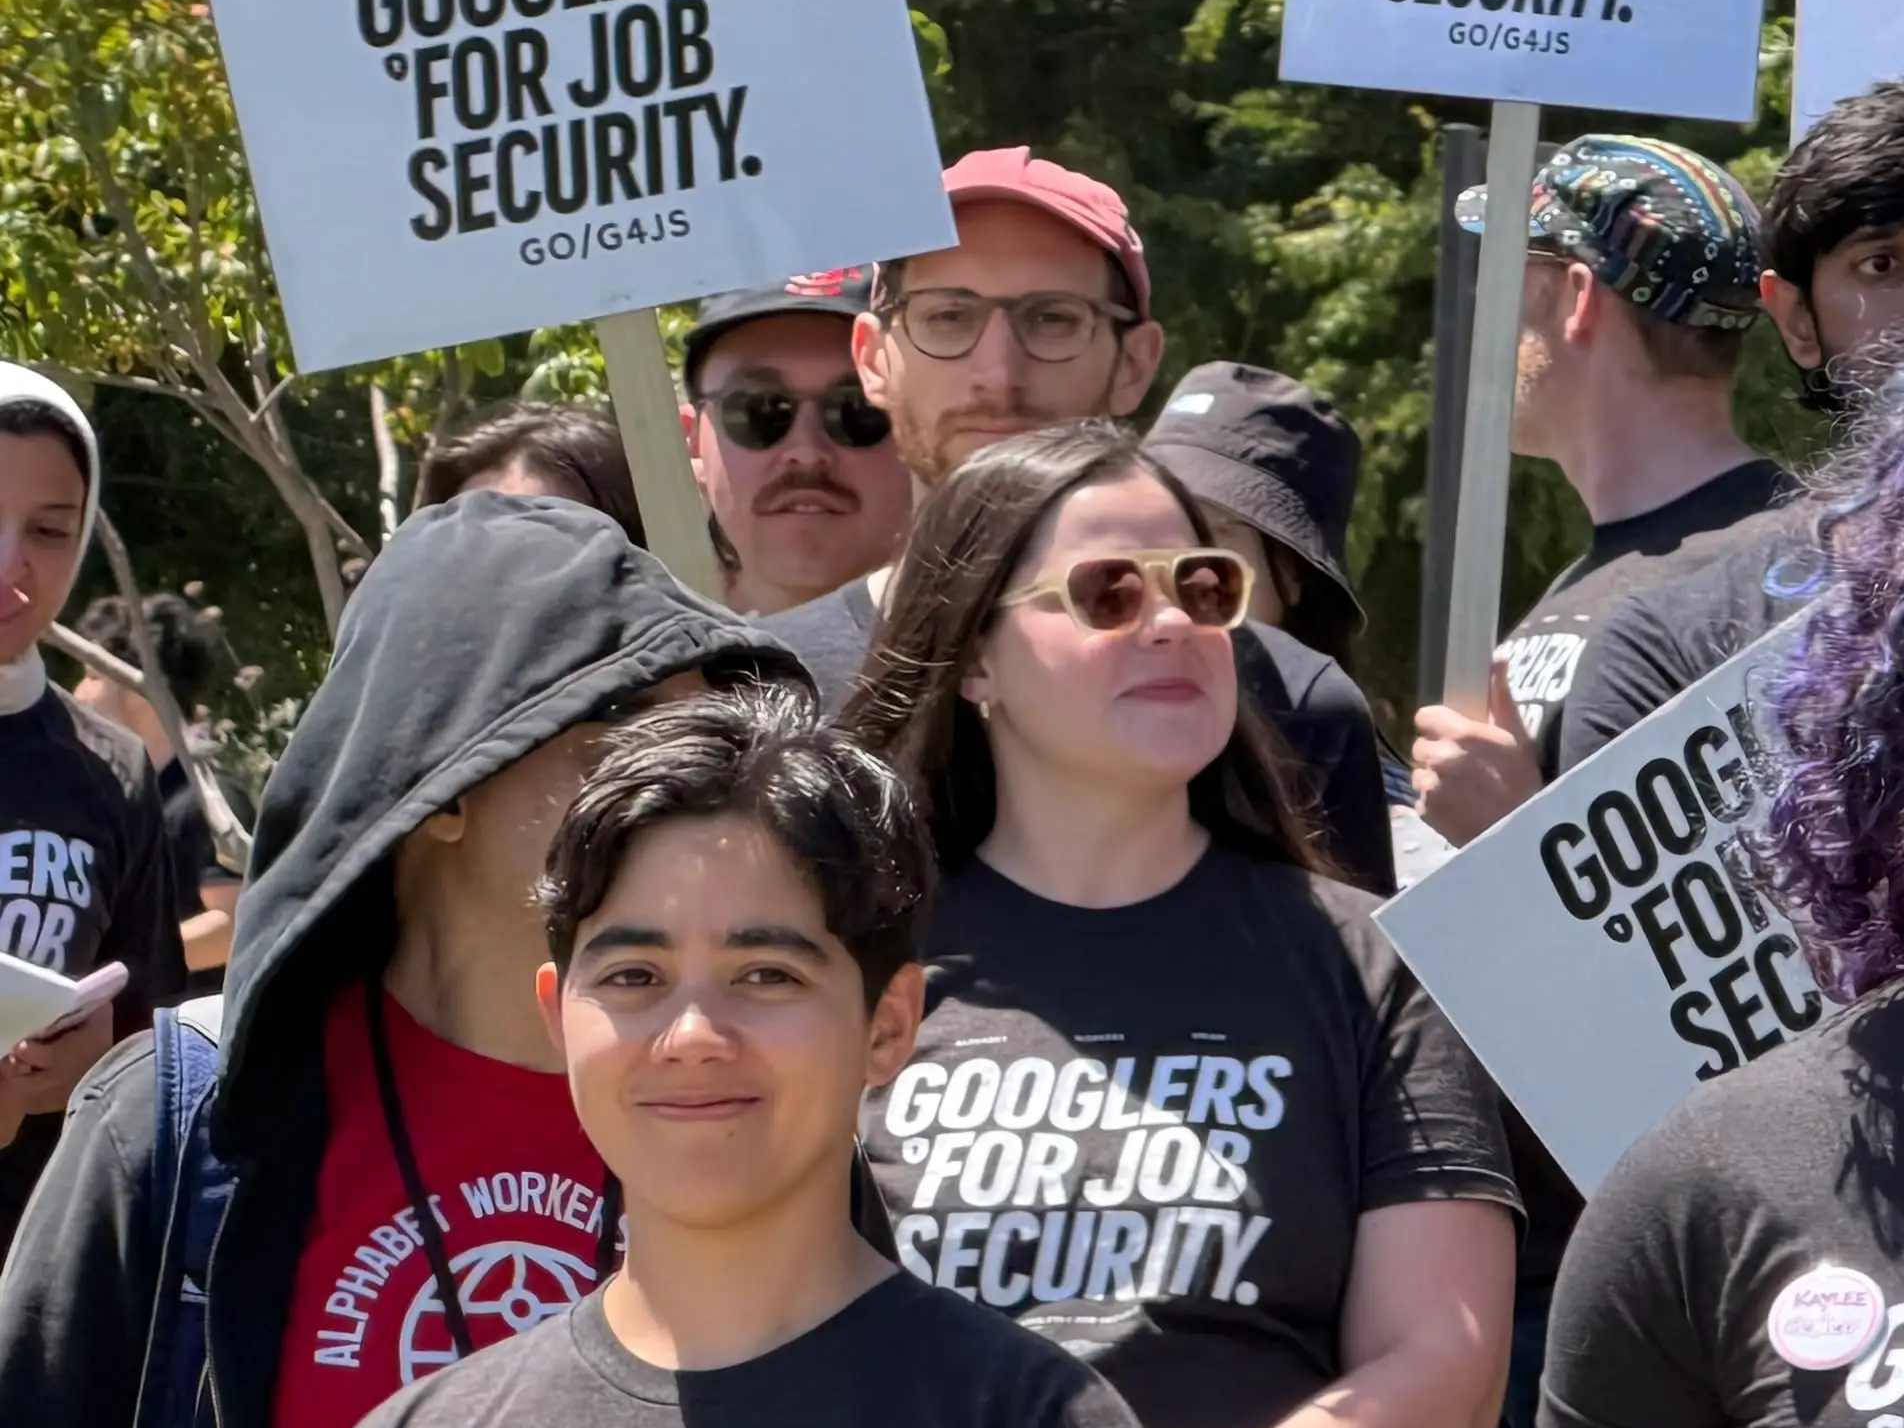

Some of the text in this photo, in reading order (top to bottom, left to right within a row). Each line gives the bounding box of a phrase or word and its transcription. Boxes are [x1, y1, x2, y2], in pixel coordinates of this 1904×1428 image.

[1448, 22, 1570, 56] GO/G4JS
[412, 27, 551, 140] FOR
[408, 85, 763, 242] SECURITY.
[520, 209, 691, 268] GO/G4JS
[885, 1055, 1294, 1138] GOOGLERS
[911, 1126, 1252, 1210] FOR JOB
[899, 1206, 1272, 1307] SECURITY.
